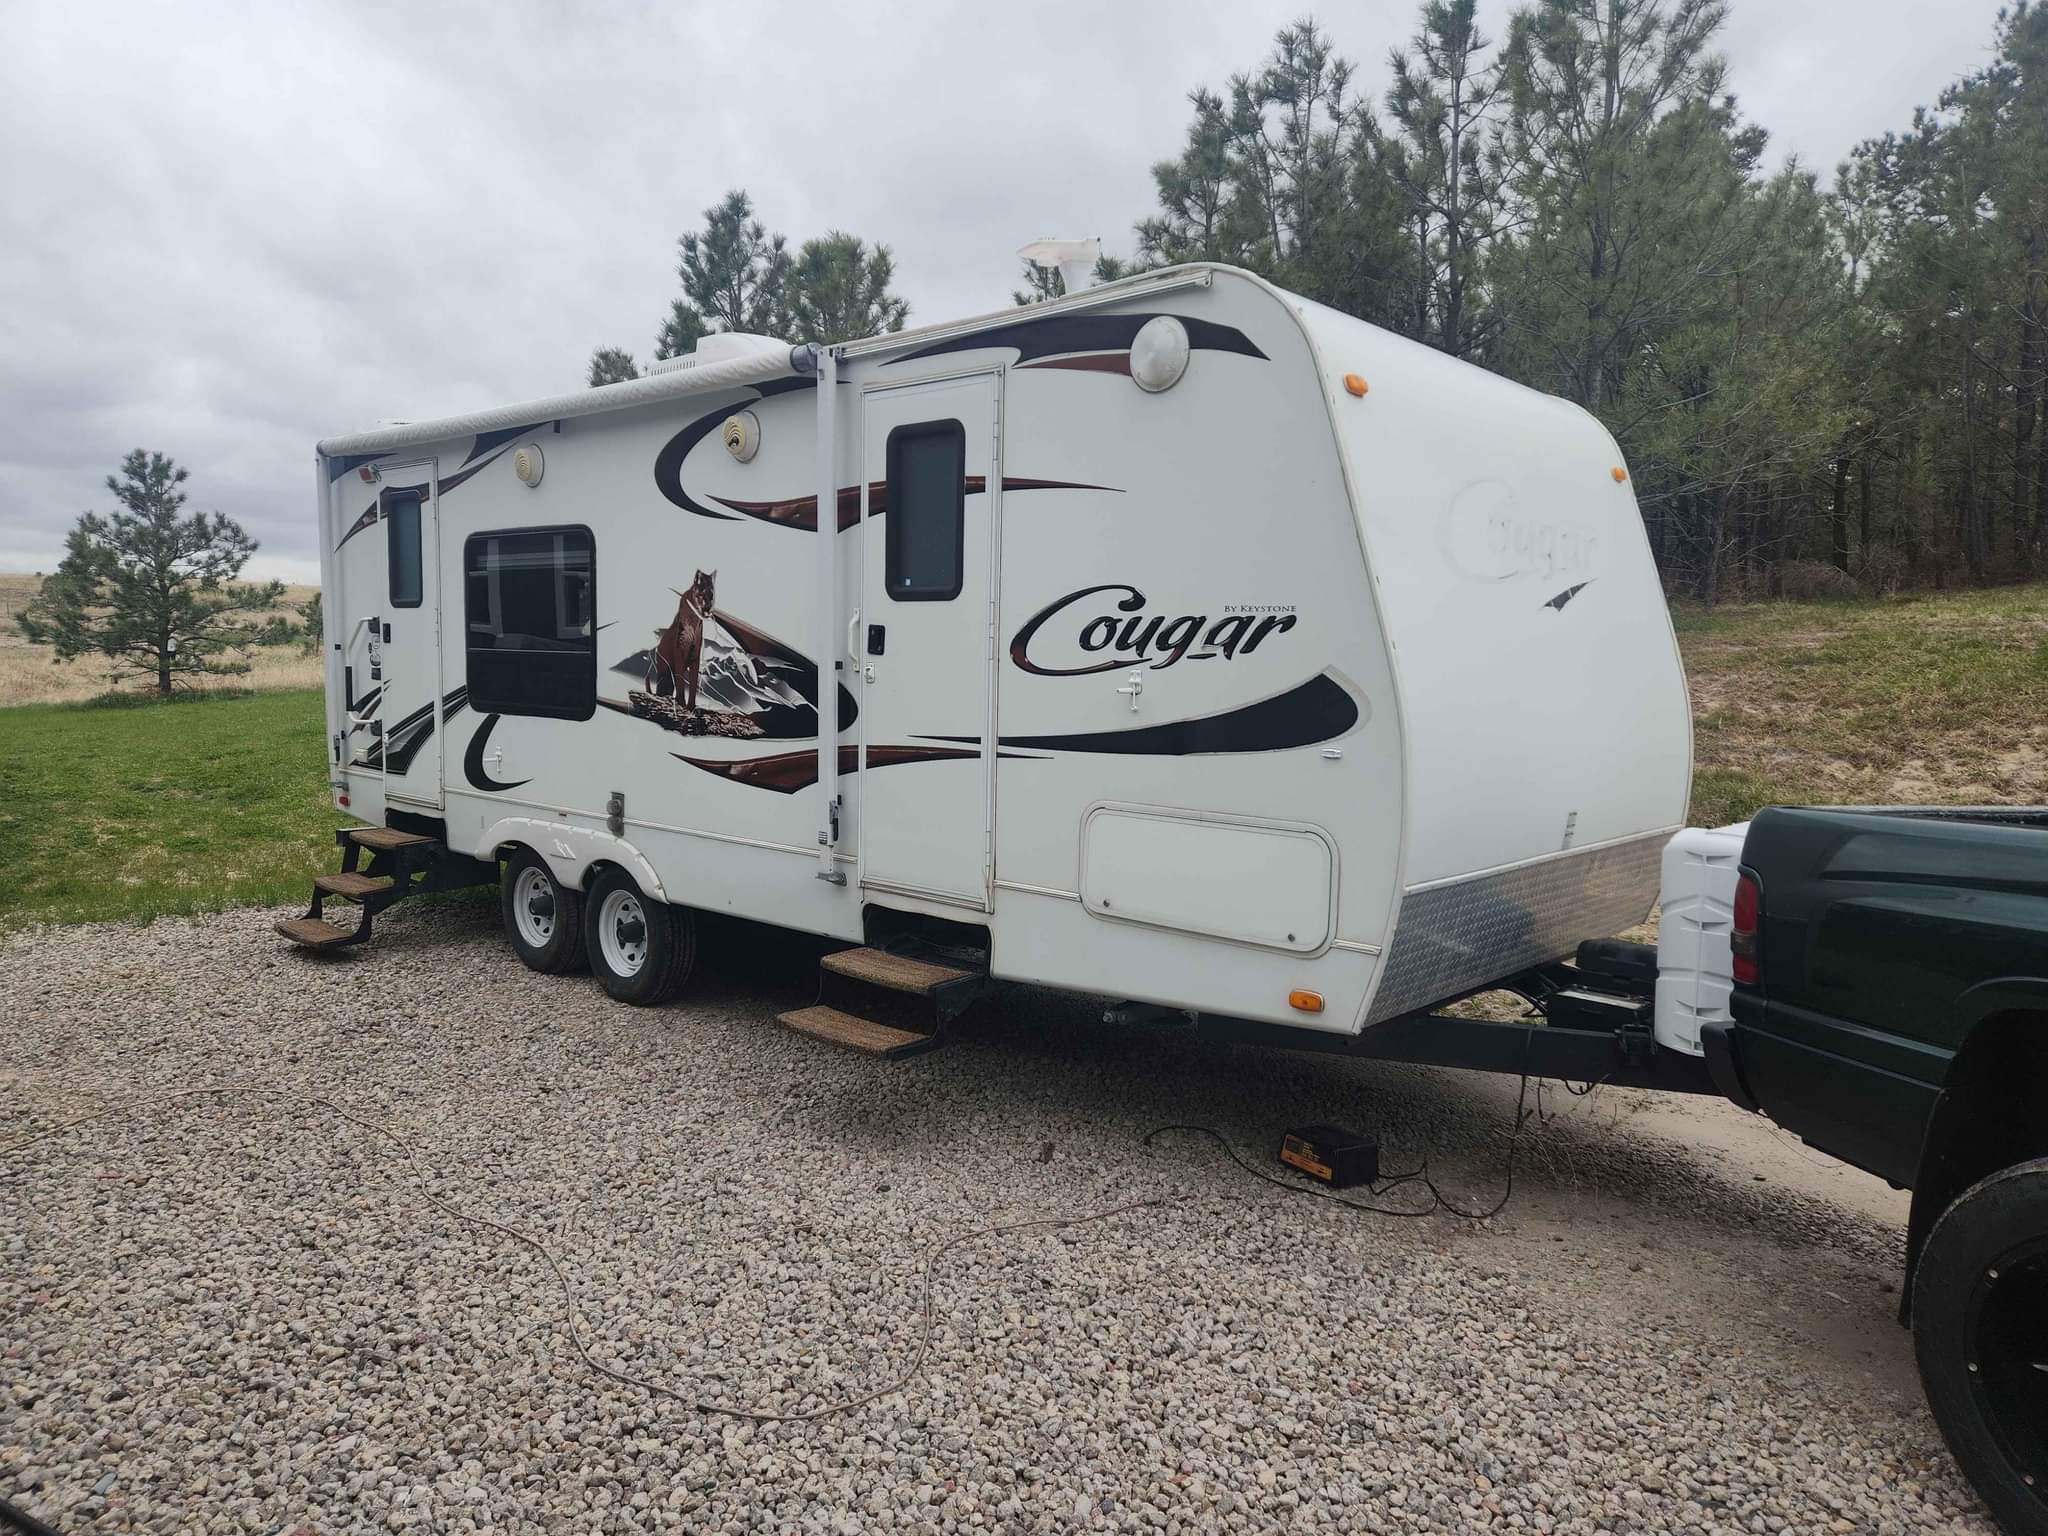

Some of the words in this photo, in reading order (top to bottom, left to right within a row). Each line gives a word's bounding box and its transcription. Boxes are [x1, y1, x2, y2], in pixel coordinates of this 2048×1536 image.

[1009, 584, 1297, 677] Cougar
[1224, 605, 1237, 613] BY
[1240, 604, 1297, 613] KEYSTONE
